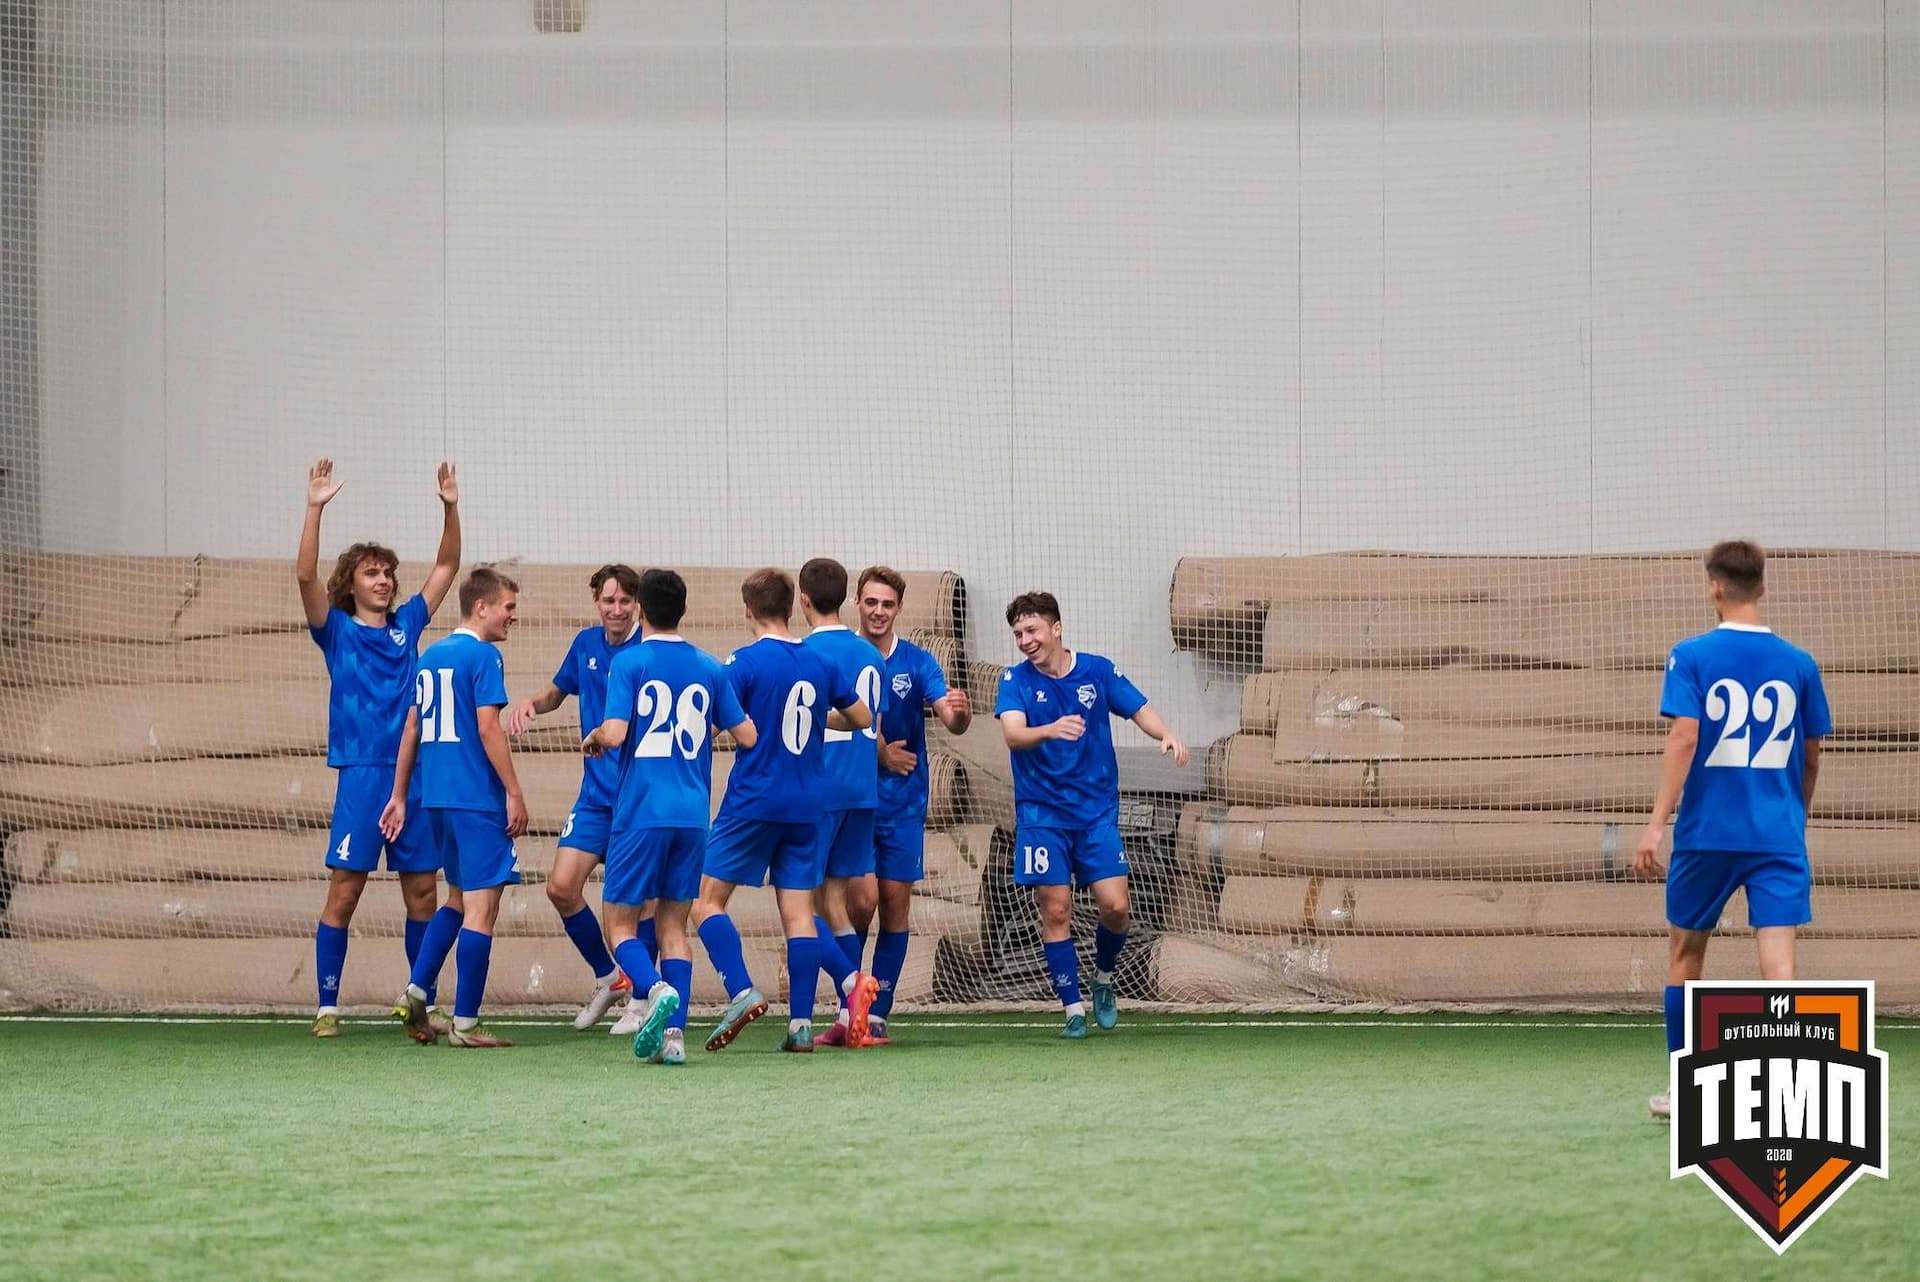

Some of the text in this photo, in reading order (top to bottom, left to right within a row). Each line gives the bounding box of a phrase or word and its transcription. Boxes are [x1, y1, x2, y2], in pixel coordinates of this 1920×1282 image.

[416, 668, 460, 744] 21
[635, 680, 710, 760] 28
[782, 680, 816, 755] 6
[824, 665, 880, 741] 0
[1704, 678, 1797, 769] 22
[336, 833, 351, 861] 4
[1024, 846, 1049, 874] 18
